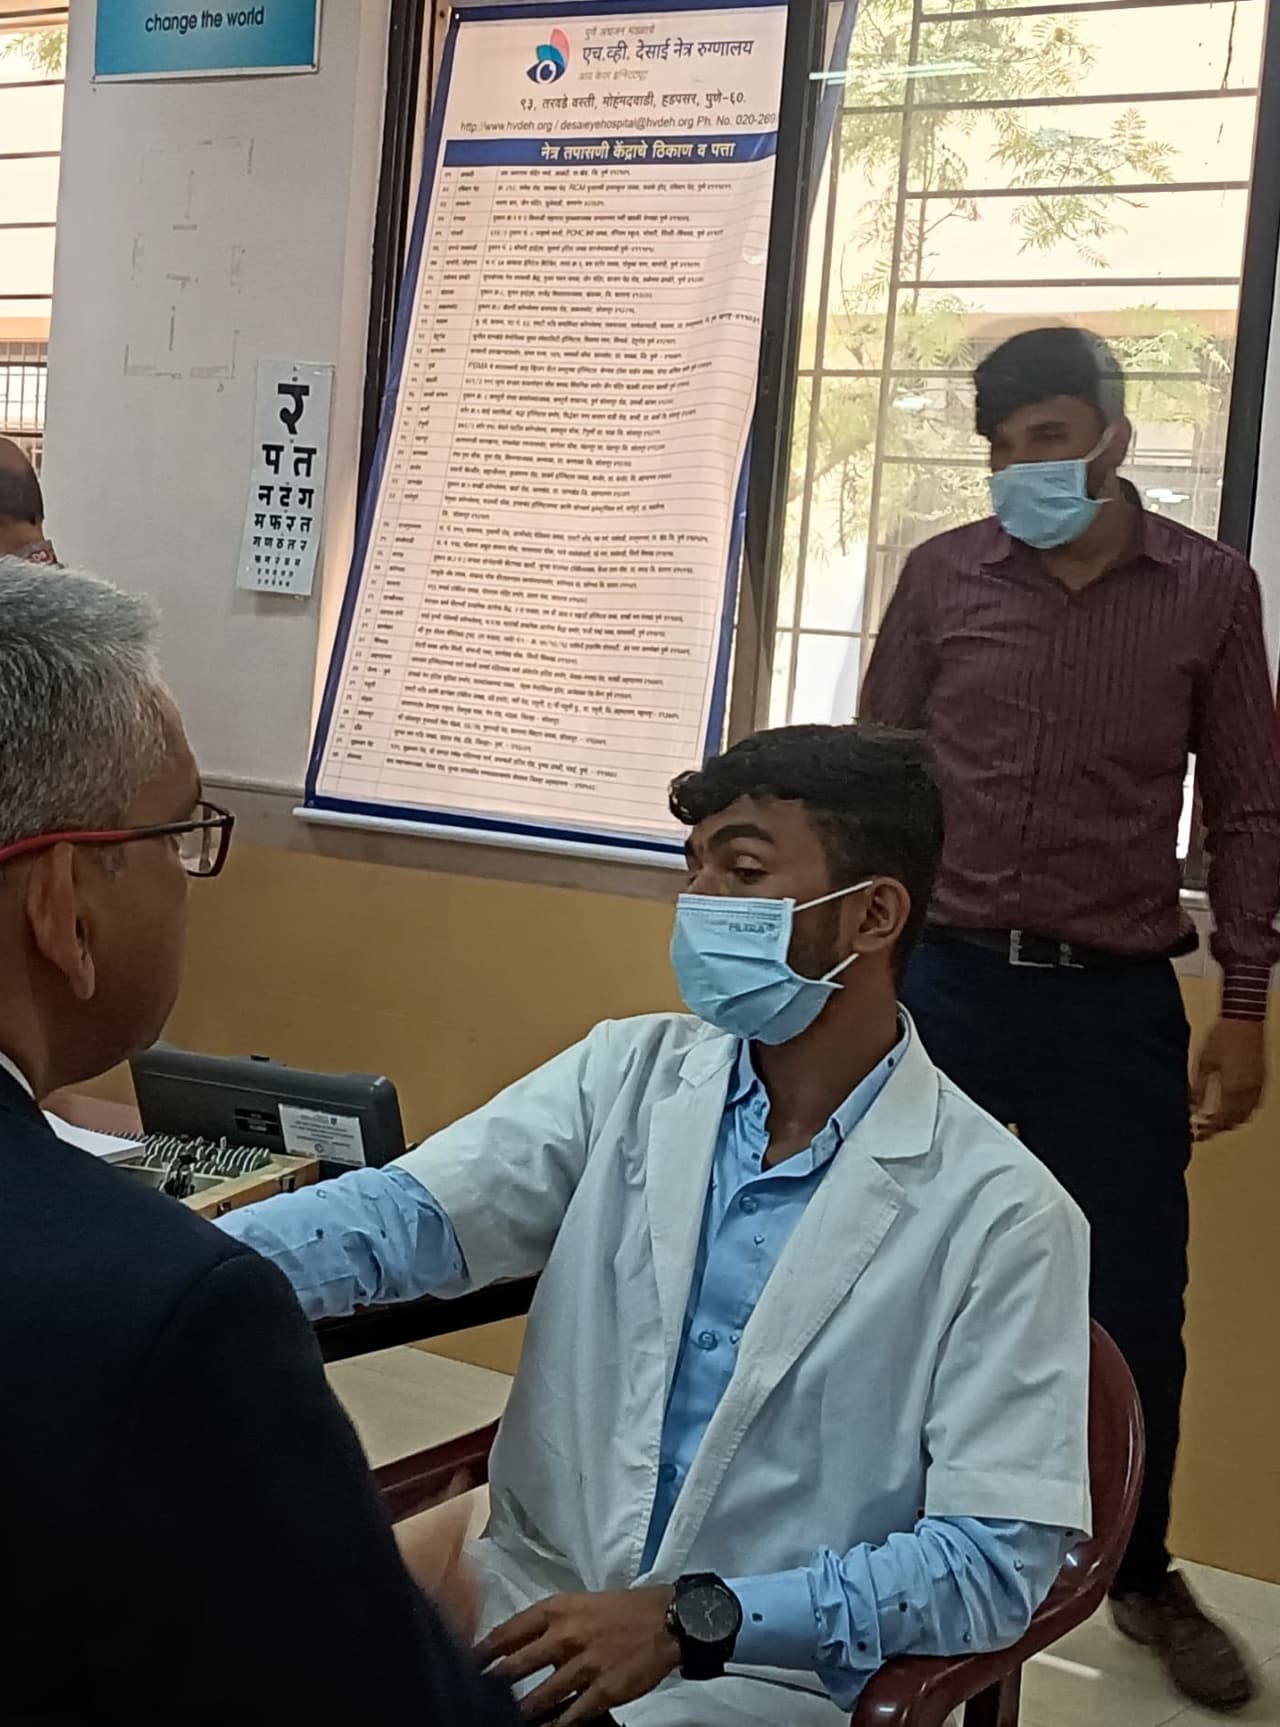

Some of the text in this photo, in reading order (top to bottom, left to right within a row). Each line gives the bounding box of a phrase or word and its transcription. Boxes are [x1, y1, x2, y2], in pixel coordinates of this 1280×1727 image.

[145, 7, 265, 35] change the world
[635, 38, 671, 62] देसाई
[673, 37, 694, 58] नेत्र
[696, 39, 755, 58] रुग्णालय
[540, 139, 737, 161] नेत्र तपासणी केंद्राचे ठिकाण व पत्ता
[277, 383, 310, 435] र
[262, 443, 317, 477] प त
[258, 485, 274, 506] न
[298, 488, 314, 509] ग
